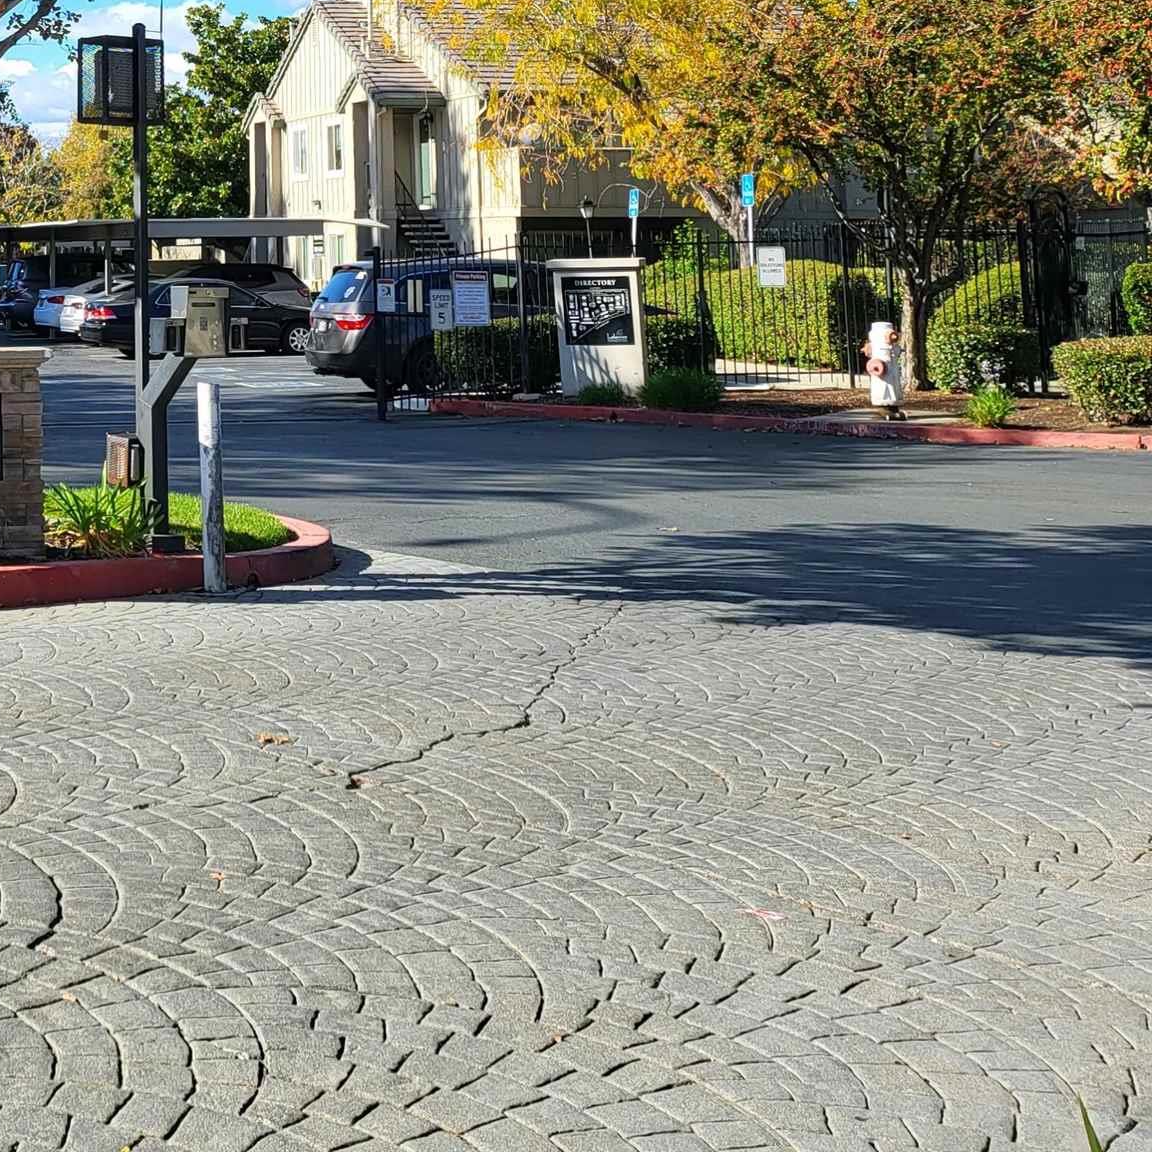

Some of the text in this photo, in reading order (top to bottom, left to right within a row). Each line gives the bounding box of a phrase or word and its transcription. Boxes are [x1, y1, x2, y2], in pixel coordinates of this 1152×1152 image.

[574, 279, 616, 287] DIRECTORY
[431, 294, 451, 302] SPEED
[437, 312, 446, 324] 5
